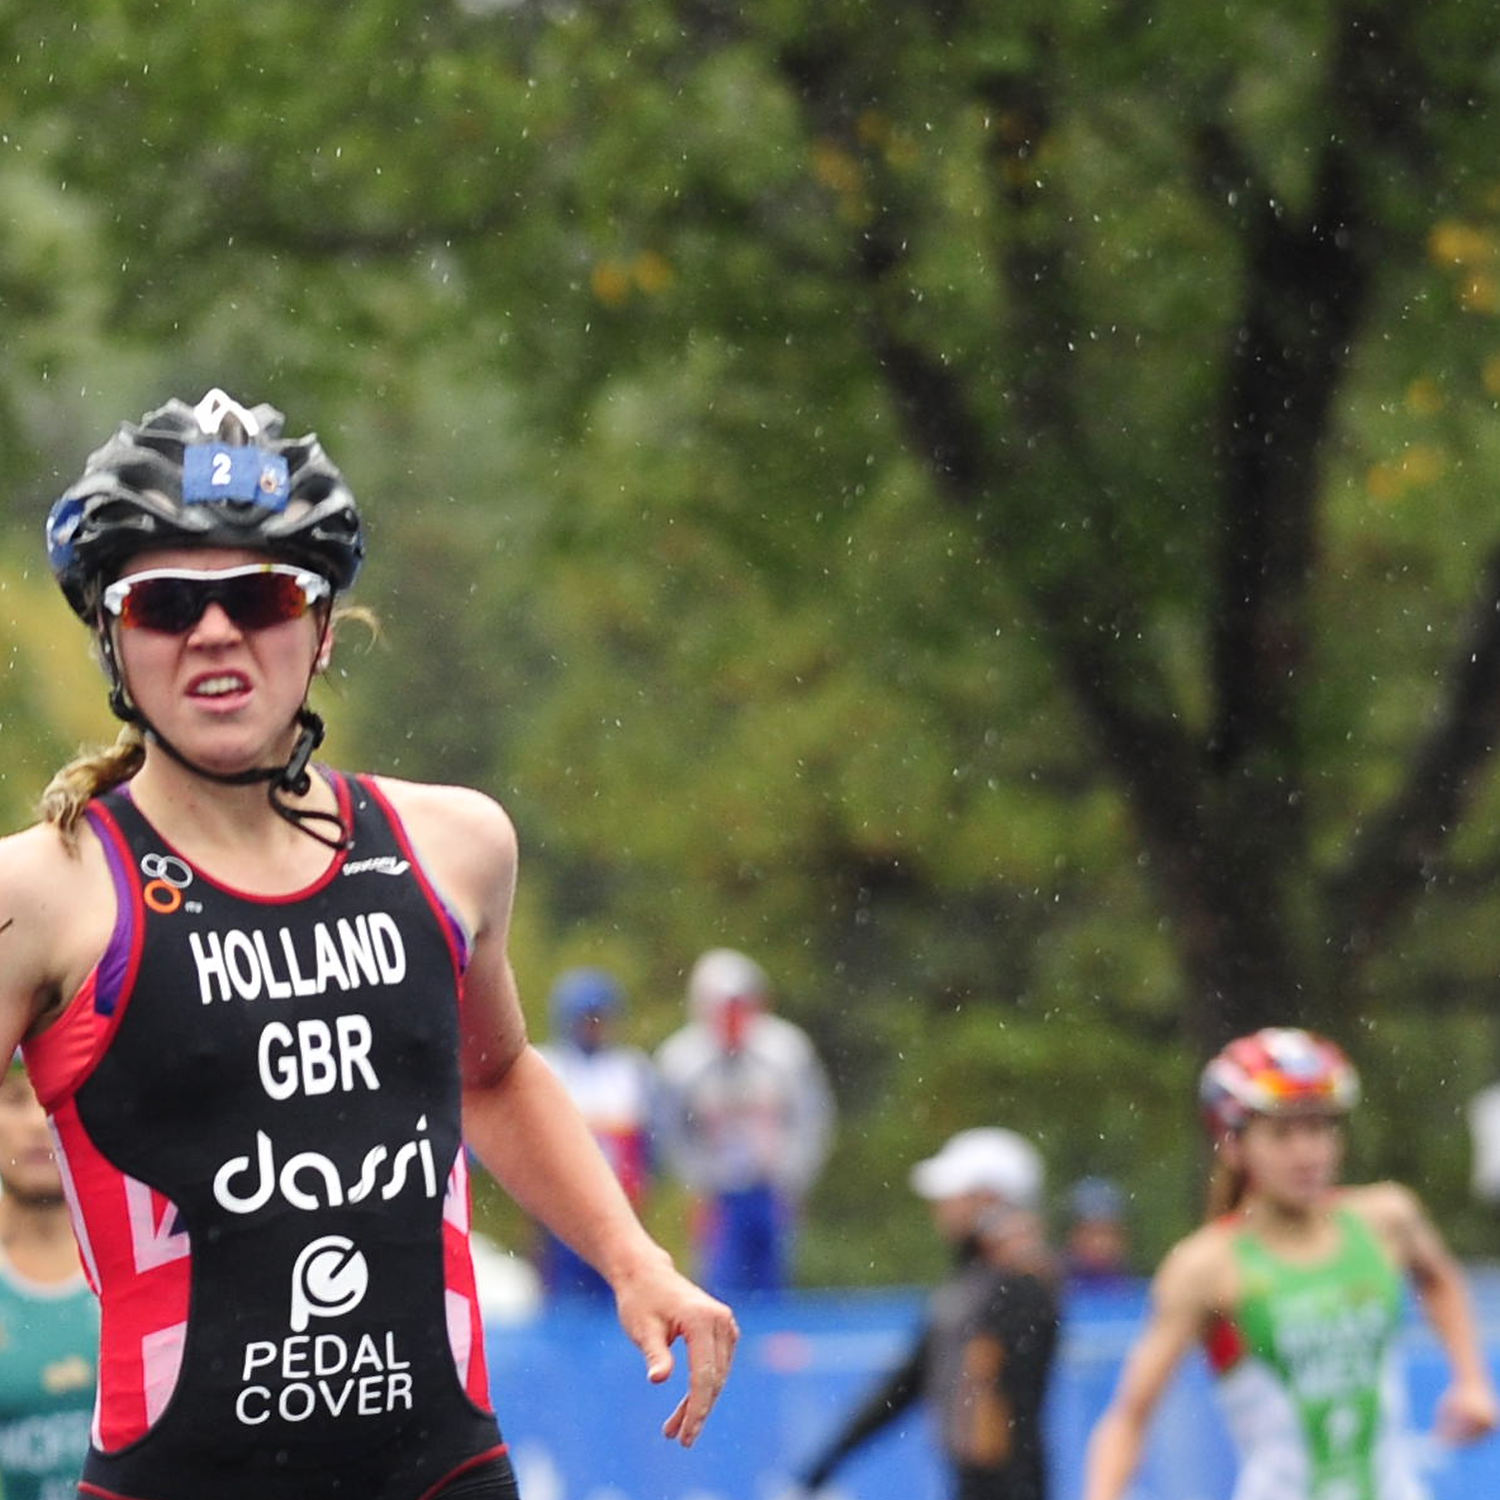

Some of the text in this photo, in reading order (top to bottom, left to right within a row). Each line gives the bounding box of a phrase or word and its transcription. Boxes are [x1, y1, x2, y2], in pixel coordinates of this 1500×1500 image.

[211, 452, 232, 486] 2
[189, 912, 407, 1005] HOLLAND
[258, 1014, 380, 1100] GBR
[213, 1114, 437, 1214] dassi
[242, 1331, 411, 1381] PEDAL
[236, 1373, 413, 1425] COVER
